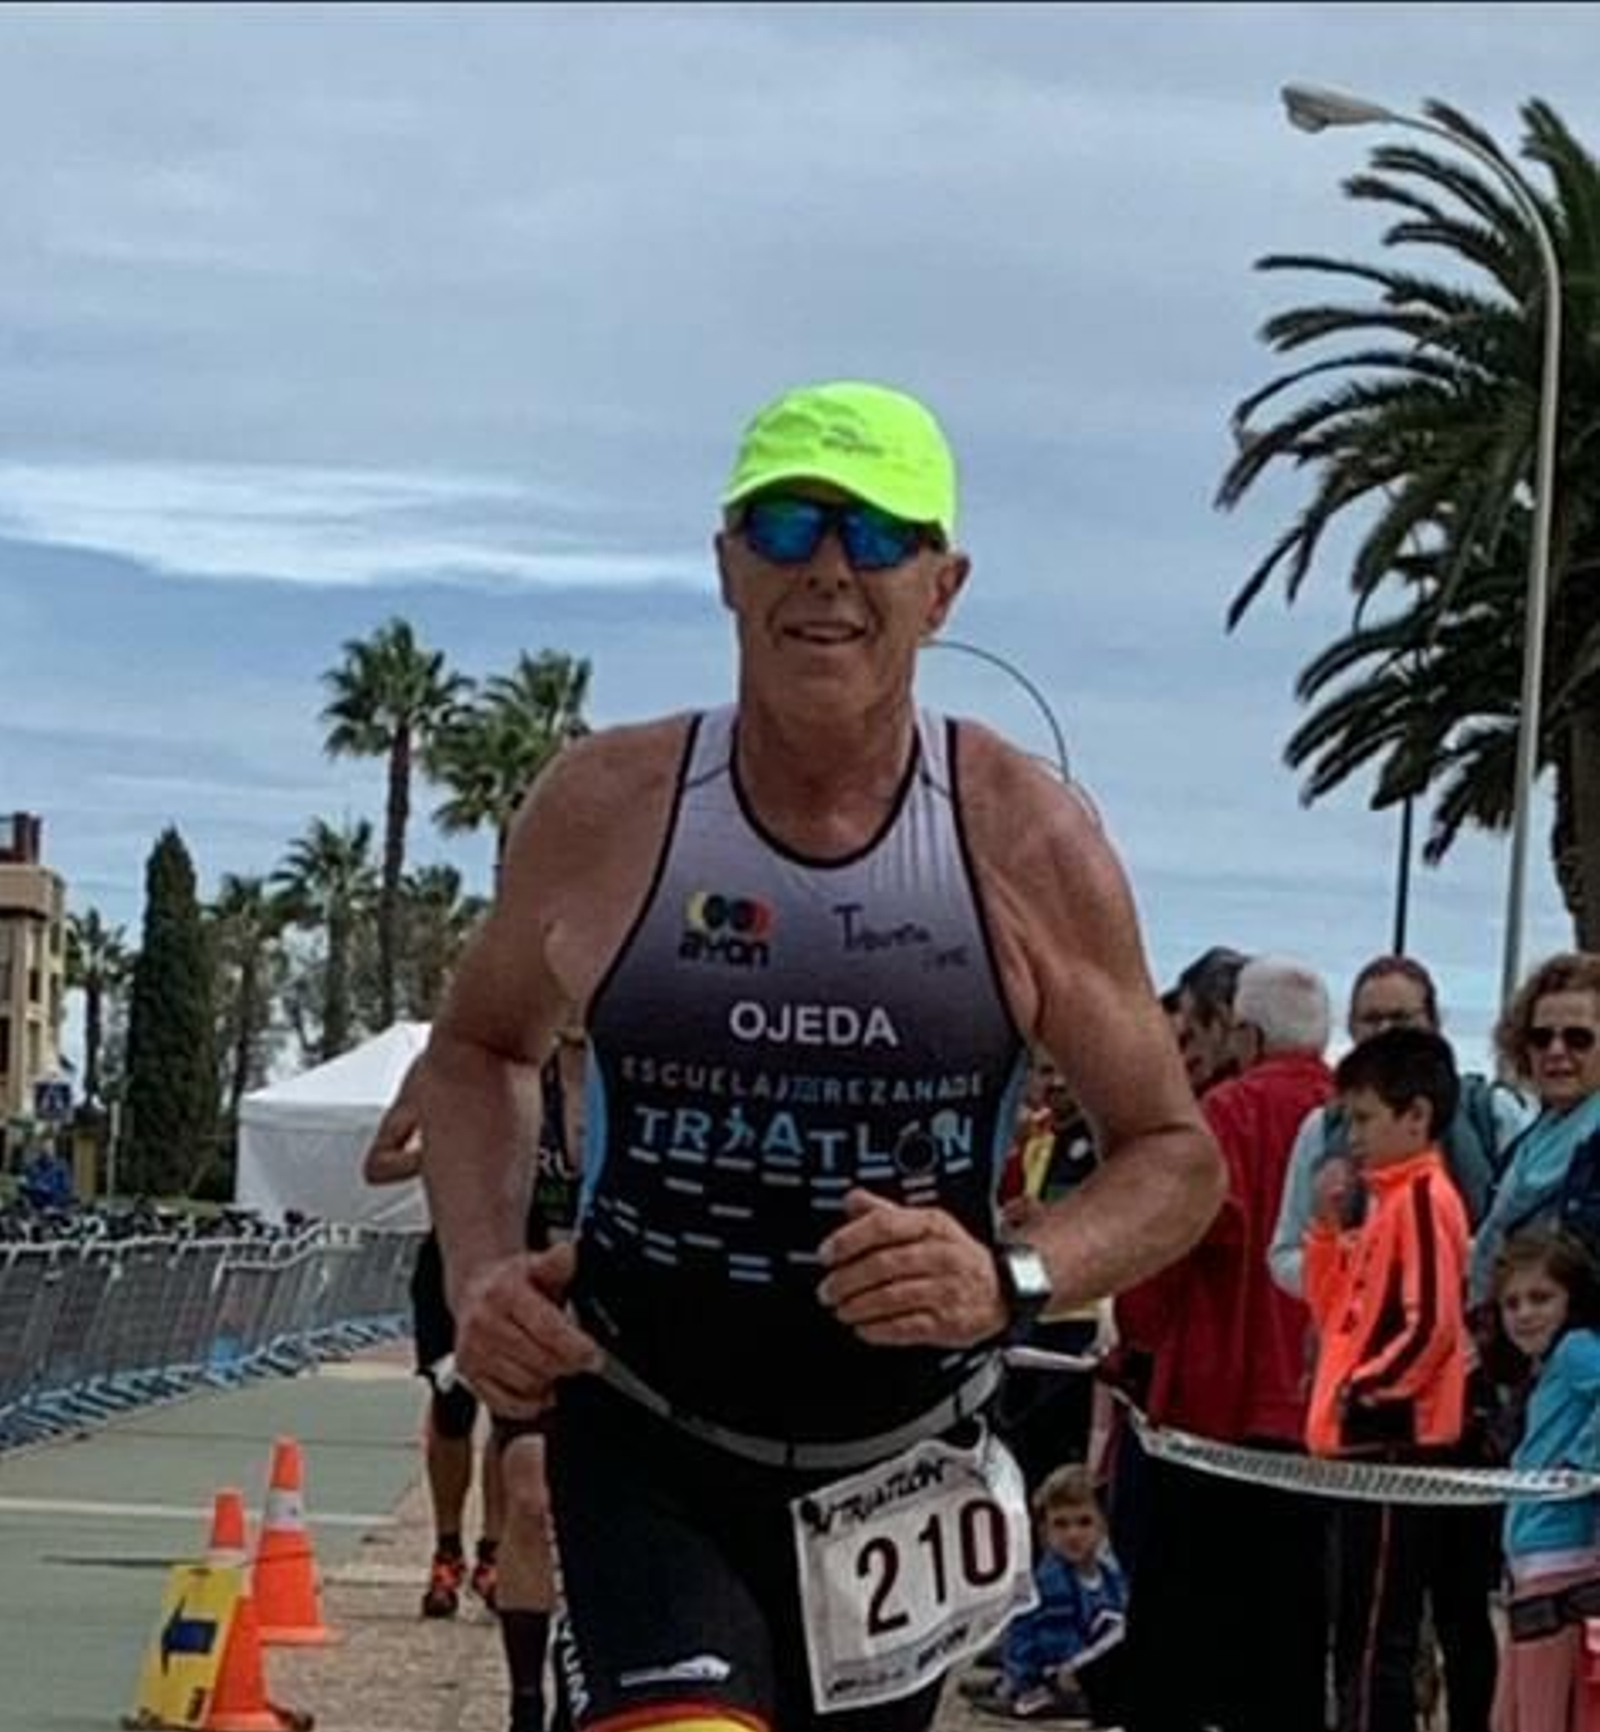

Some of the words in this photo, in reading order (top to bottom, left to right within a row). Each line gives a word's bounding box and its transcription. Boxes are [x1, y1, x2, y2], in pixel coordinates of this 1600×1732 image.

[729, 1000, 899, 1047] OJEDA
[621, 1055, 771, 1098] ESCUELA
[857, 1499, 1008, 1636] 210
